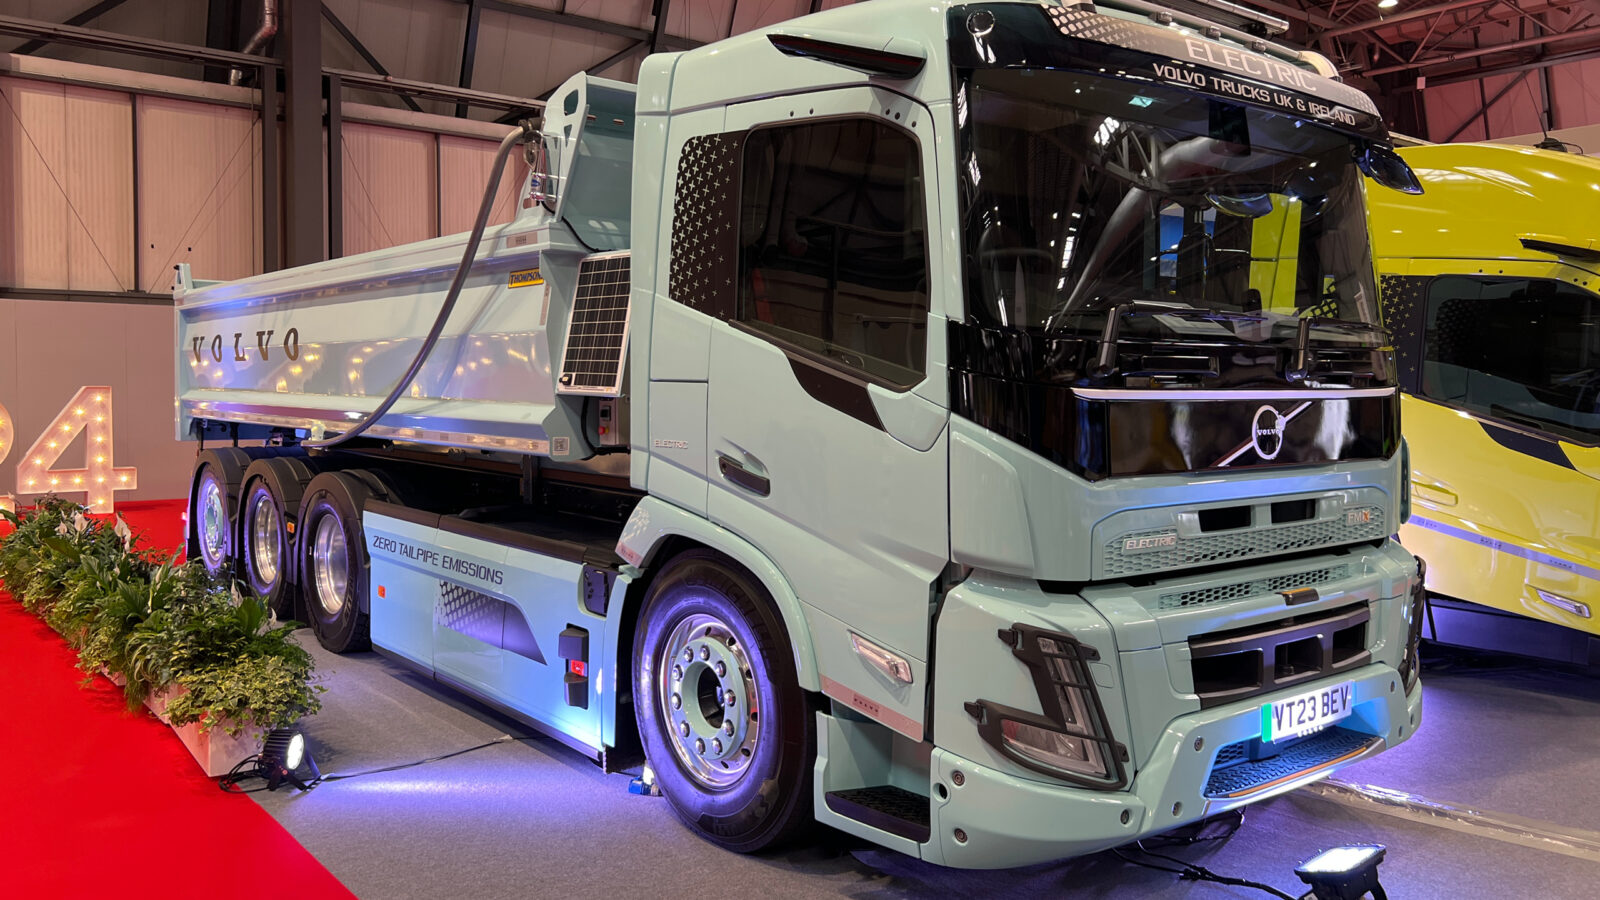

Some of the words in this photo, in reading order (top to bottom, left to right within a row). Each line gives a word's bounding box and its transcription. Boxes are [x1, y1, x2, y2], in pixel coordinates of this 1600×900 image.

[1185, 37, 1317, 92] ELECTRIC
[1152, 62, 1206, 88] VOLVO
[1210, 76, 1271, 103] TRUCKS
[1274, 93, 1293, 109] UK
[1296, 98, 1307, 112] &
[1308, 101, 1356, 127] IRELAND
[192, 327, 299, 363] VOLVO
[1256, 428, 1280, 436] VOLVO
[373, 535, 397, 553] ZERO
[398, 542, 440, 567] TAILPIPE
[441, 555, 504, 585] EMISSIONS
[1125, 535, 1176, 550] ELECTRIC
[1274, 695, 1317, 732] VT23
[1321, 684, 1349, 718] BEV
